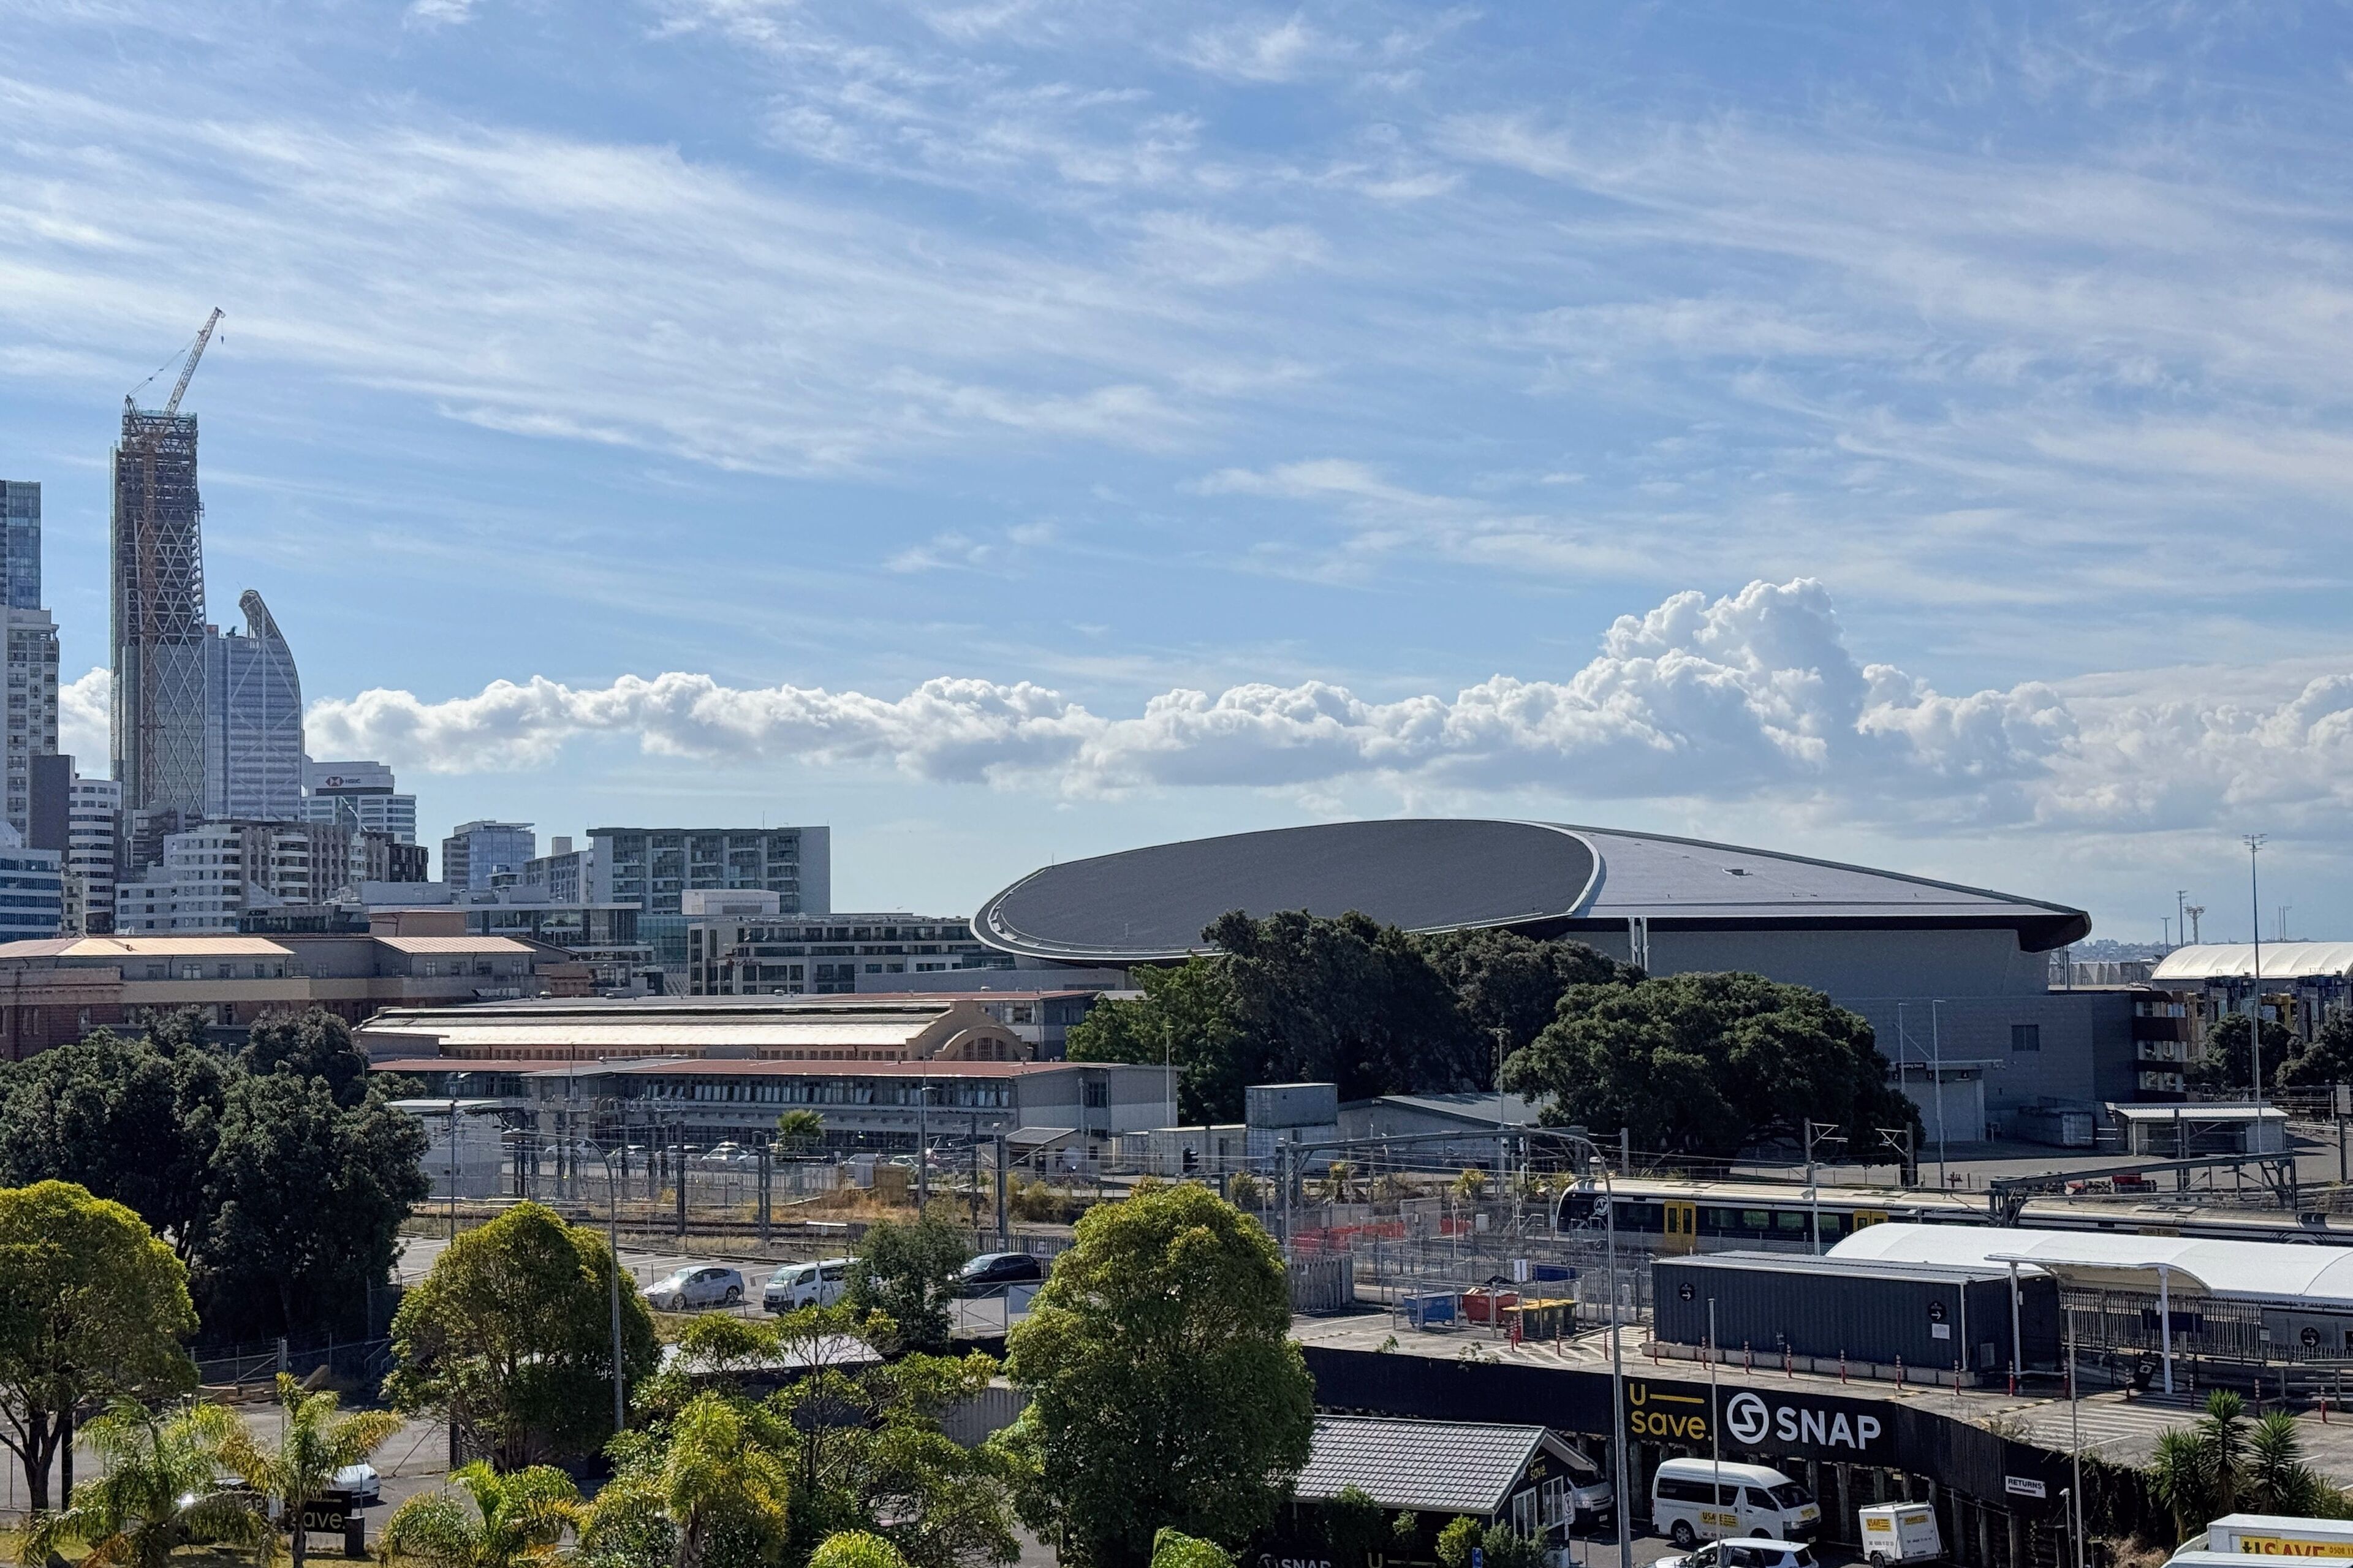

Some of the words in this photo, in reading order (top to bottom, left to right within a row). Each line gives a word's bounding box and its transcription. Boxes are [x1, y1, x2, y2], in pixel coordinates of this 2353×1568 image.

[1776, 1407, 1881, 1450] SNAP
[2008, 1478, 2043, 1490] RETURNS
[1702, 1512, 1723, 1522] USAE
[2329, 1545, 2345, 1555] 0508
